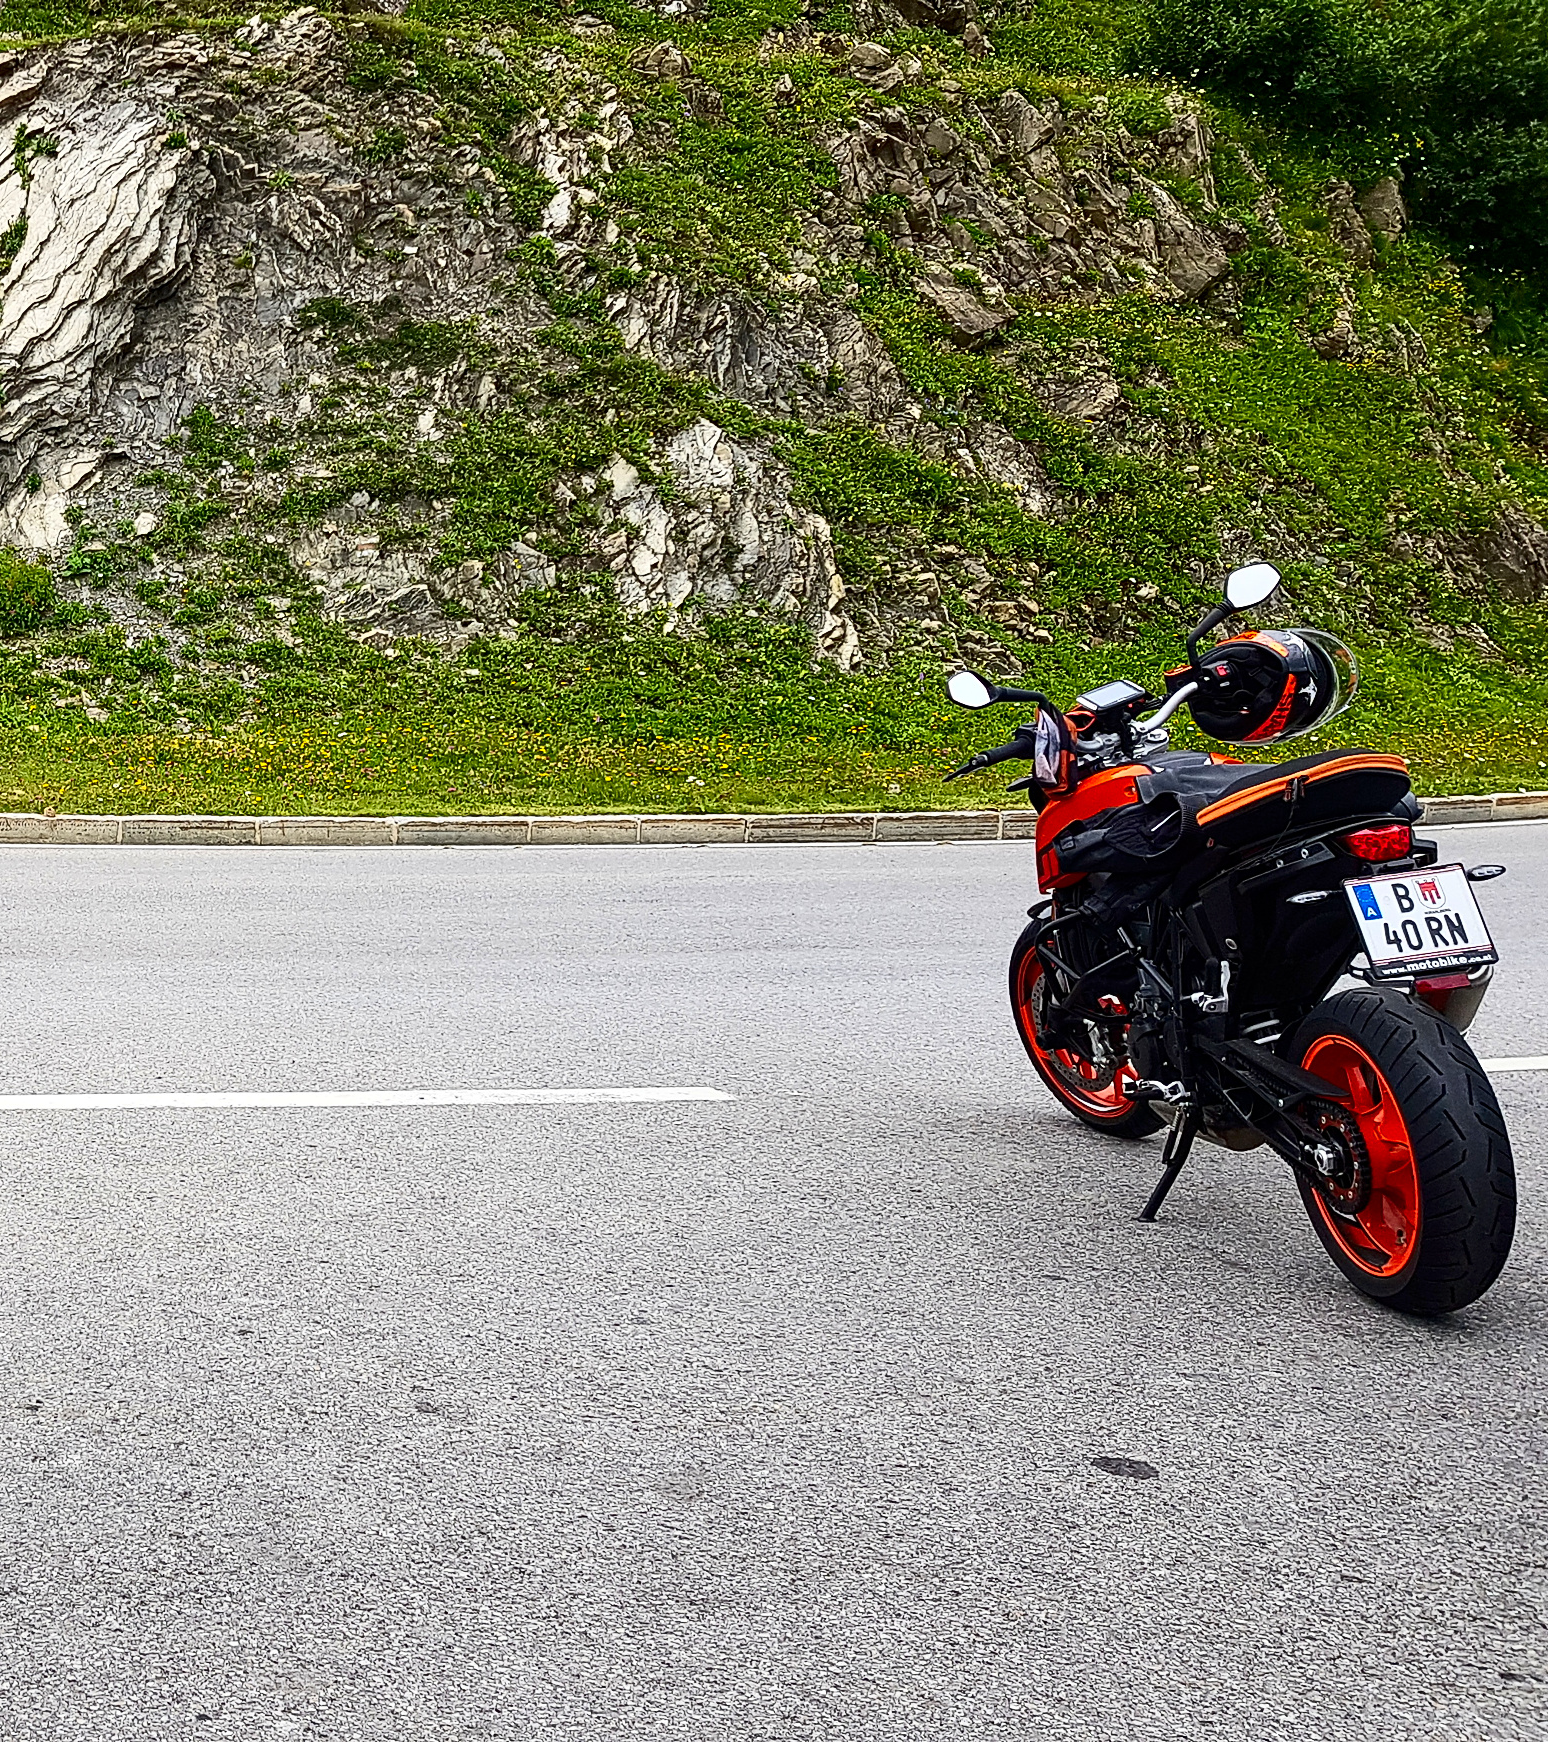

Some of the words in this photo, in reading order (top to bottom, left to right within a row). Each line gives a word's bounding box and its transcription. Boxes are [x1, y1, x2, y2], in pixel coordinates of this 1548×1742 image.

[1390, 883, 1415, 913] B
[1366, 906, 1378, 918] A
[1383, 919, 1424, 953] 40
[1424, 912, 1469, 948] RN
[1381, 953, 1494, 975] www.motobike.co.at
